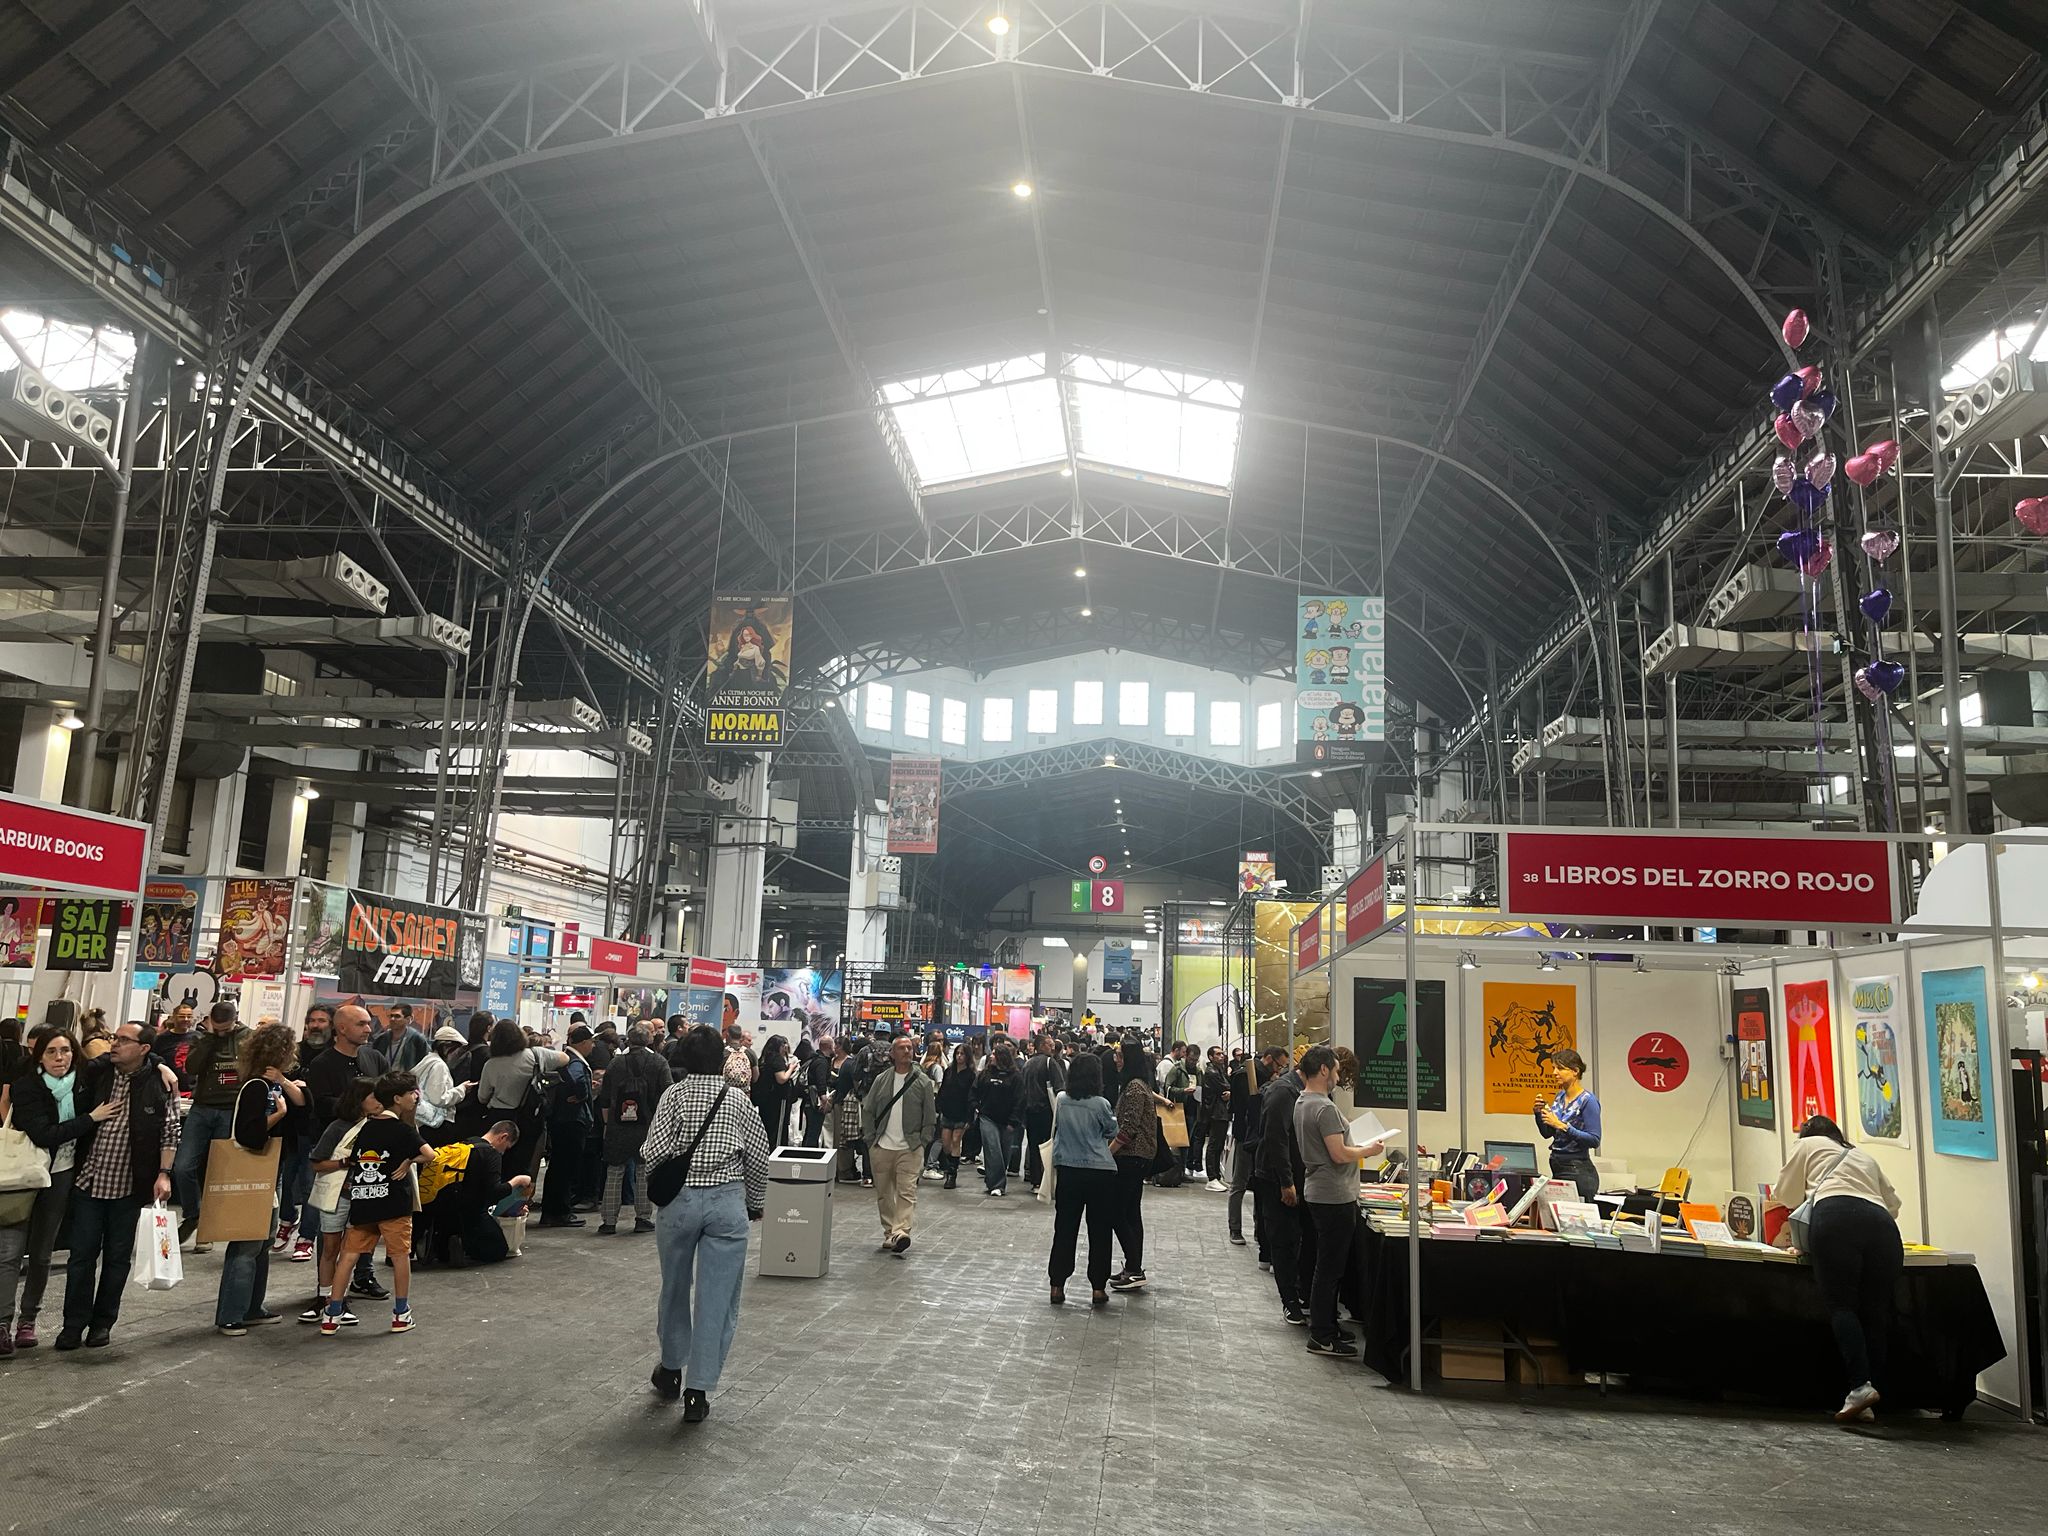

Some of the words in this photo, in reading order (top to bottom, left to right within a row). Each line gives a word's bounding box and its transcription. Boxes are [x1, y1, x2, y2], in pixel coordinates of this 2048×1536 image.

[1354, 598, 1385, 741] mafalda
[711, 696, 741, 706] ANNE
[743, 696, 782, 707] BONNY
[710, 713, 779, 731] NORMA
[710, 731, 779, 742] Editorial
[54, 838, 104, 862] BOOKS
[231, 880, 258, 894] TIKI
[1523, 873, 1539, 883] 38
[1545, 865, 1636, 887] LIBROS
[1643, 867, 1693, 888] DEL
[1699, 868, 1789, 891] ZORRO
[1798, 871, 1874, 893] ROJO
[1101, 886, 1115, 907] 8
[56, 932, 108, 960] DER
[372, 954, 433, 986] FEST!!
[487, 1000, 509, 1011] Balears
[873, 1006, 899, 1014] SORTIDA
[1650, 1038, 1664, 1053] Z
[1652, 1072, 1667, 1088] R
[251, 1182, 272, 1190] TIMES
